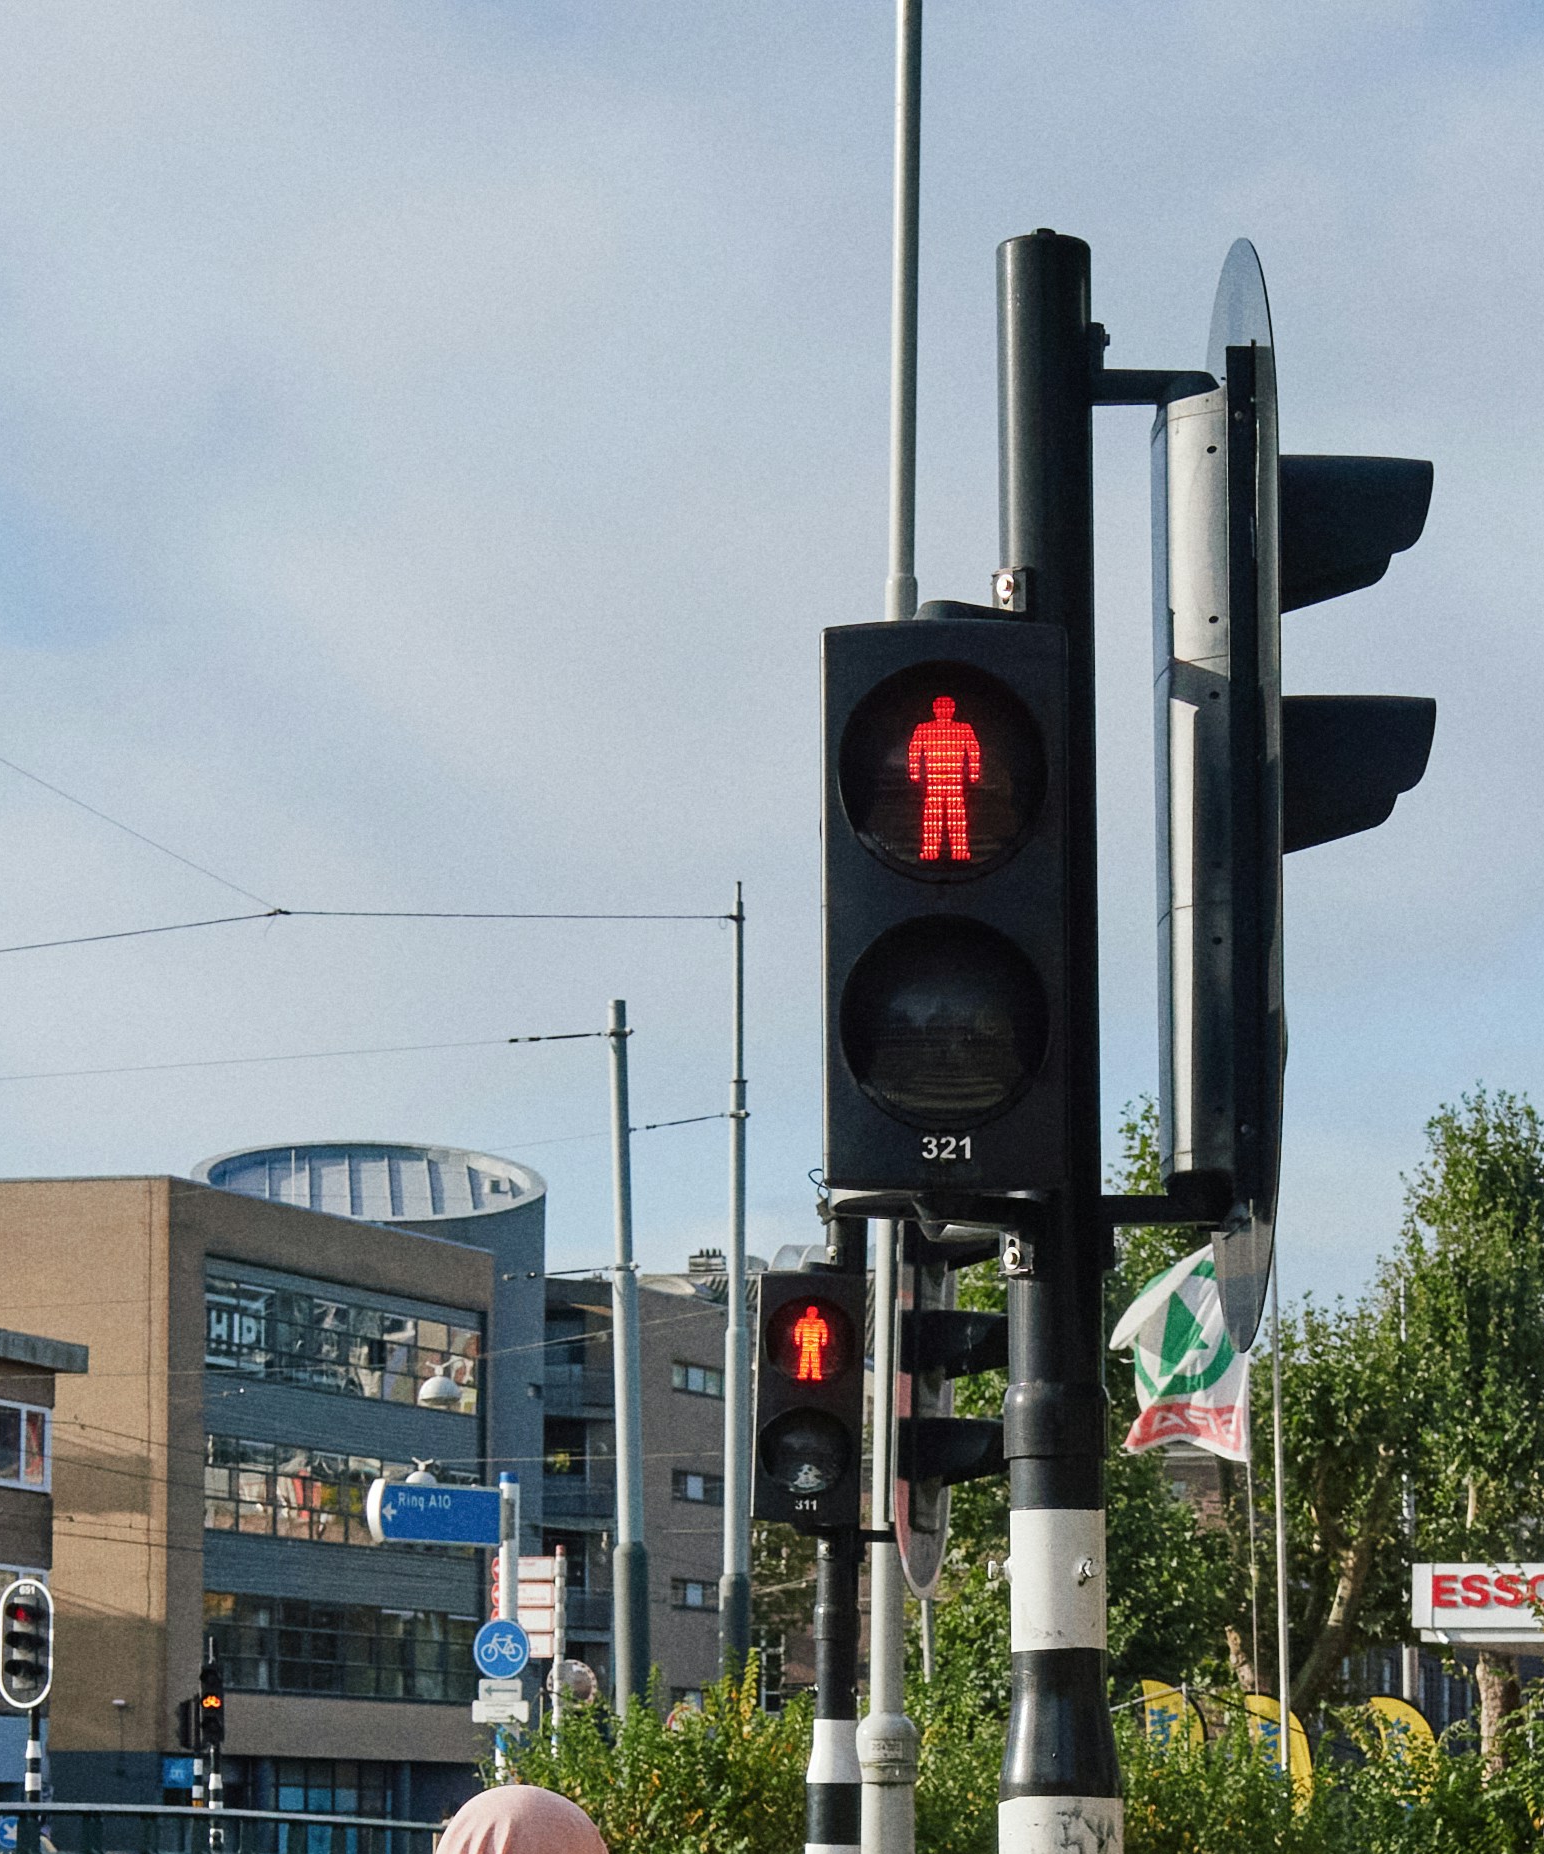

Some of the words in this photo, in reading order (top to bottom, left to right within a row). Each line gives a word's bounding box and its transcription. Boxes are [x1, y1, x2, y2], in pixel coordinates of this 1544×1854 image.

[921, 1136, 971, 1159] 321
[398, 1492, 424, 1511] Ring
[428, 1494, 452, 1510] A10
[795, 1499, 817, 1511] 311
